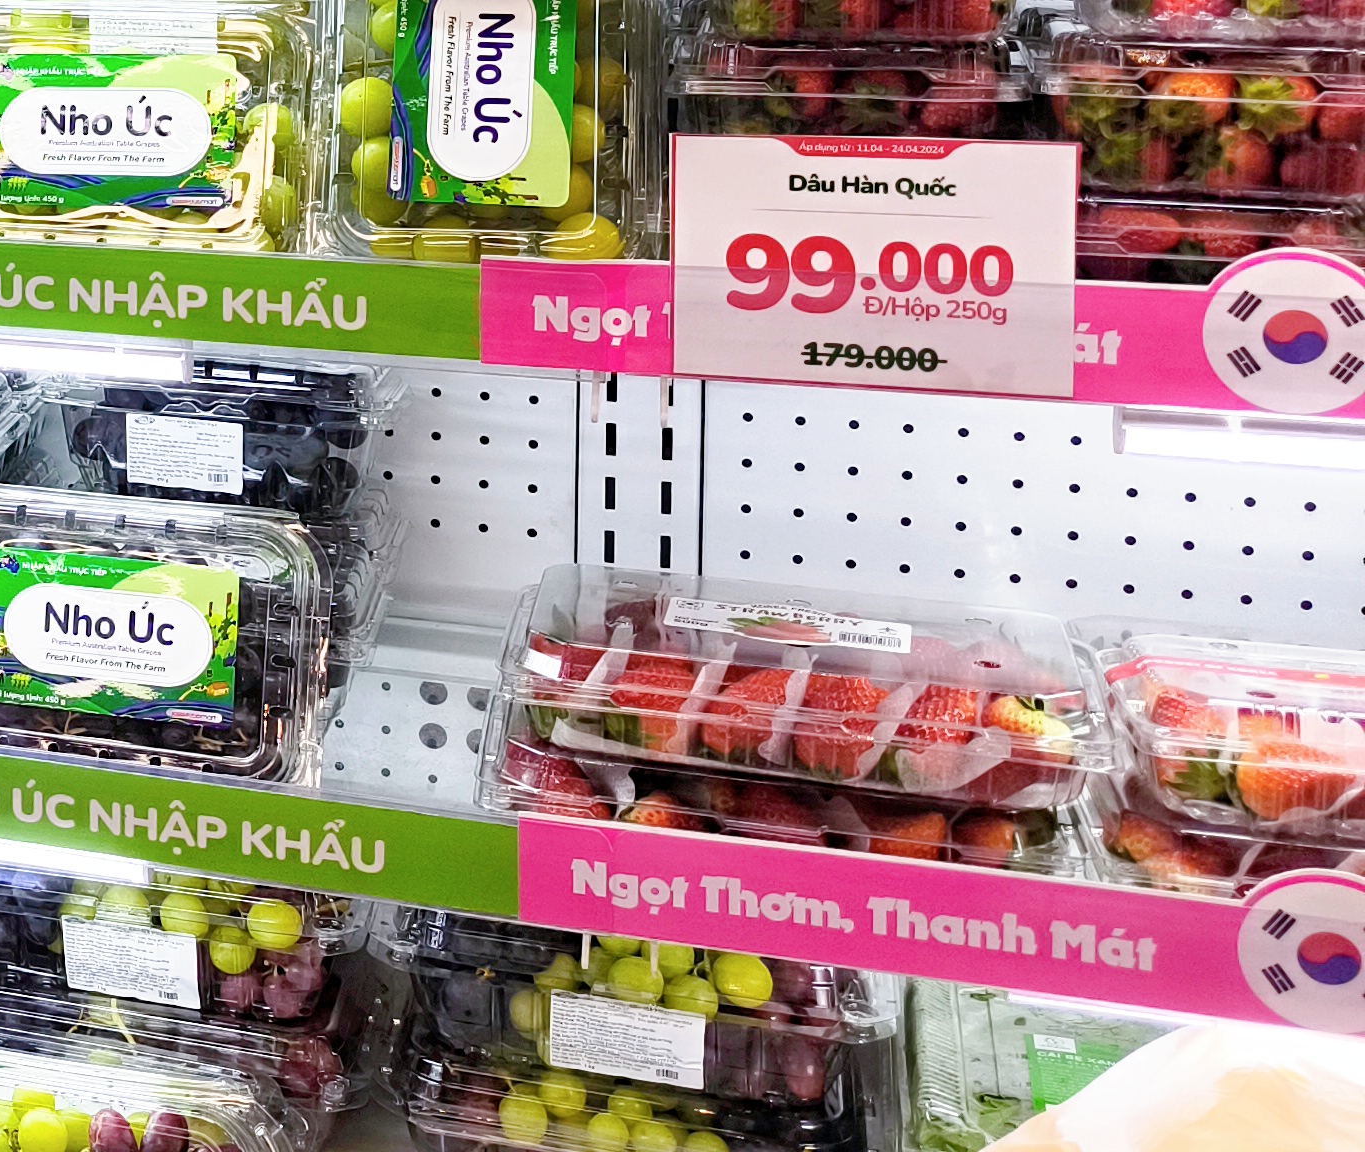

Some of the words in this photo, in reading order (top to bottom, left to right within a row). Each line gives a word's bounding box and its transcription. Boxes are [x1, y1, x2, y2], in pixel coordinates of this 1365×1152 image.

[447, 16, 457, 39] Fresh
[447, 42, 456, 66] Flavor
[475, 13, 516, 85] Nho
[446, 68, 455, 93] From
[41, 105, 112, 135] Nho
[126, 95, 172, 136] Úc
[444, 95, 454, 112] The
[472, 97, 523, 144] Úc
[442, 114, 450, 136] Farm
[800, 142, 815, 153] Áp
[817, 144, 840, 155] dụng
[856, 144, 883, 153] 11.04
[891, 144, 945, 155] 24.04.2024
[789, 174, 834, 192] Dâu
[842, 175, 888, 194] Hàn
[895, 177, 956, 199] Quốc
[726, 233, 1014, 313] 99.000
[69, 272, 207, 328] NHẬP
[223, 278, 366, 330] KHẨU
[863, 296, 940, 321] Đ/Hộp
[946, 300, 1008, 325] 250g
[532, 295, 651, 342] Ngọt
[1076, 323, 1122, 365] át
[801, 341, 948, 373] 179.000
[44, 601, 115, 638] Nho
[129, 601, 174, 646] Úc
[13, 779, 75, 828] ÚC
[90, 799, 227, 854] NHẬP
[242, 819, 385, 873] KHẨU
[571, 859, 689, 915] Ngọt
[700, 876, 854, 933] Thơm,
[867, 897, 1037, 955] Thanh
[1050, 921, 1157, 971] Mát
